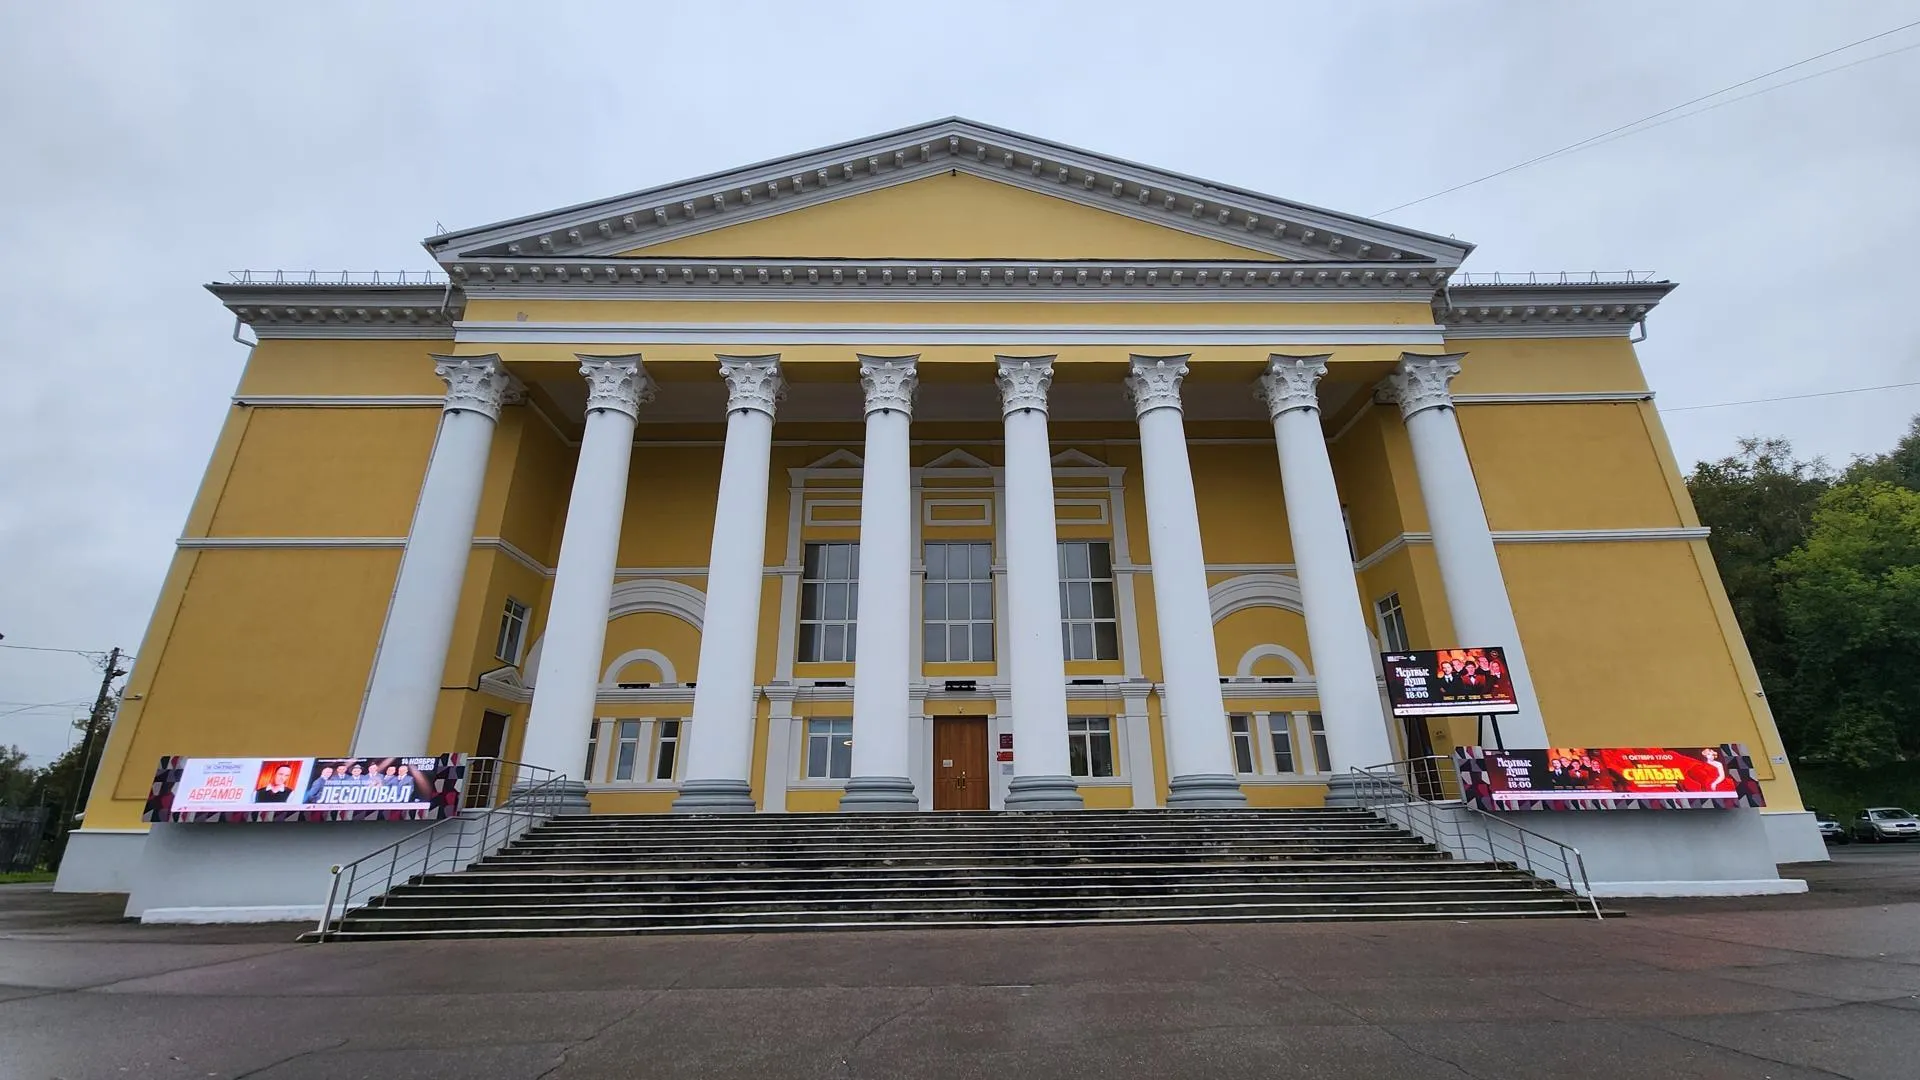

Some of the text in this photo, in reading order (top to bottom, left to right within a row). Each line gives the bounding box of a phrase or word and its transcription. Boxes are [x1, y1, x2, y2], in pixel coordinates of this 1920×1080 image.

[1405, 691, 1429, 699] 18:00
[1623, 769, 1684, 780] СИЛЬВА
[205, 776, 233, 787] ИВАН
[1507, 781, 1532, 789] 18:00
[189, 788, 243, 800] АБРАМОВ
[317, 786, 411, 803] ЛЕСОПОВАЛ
